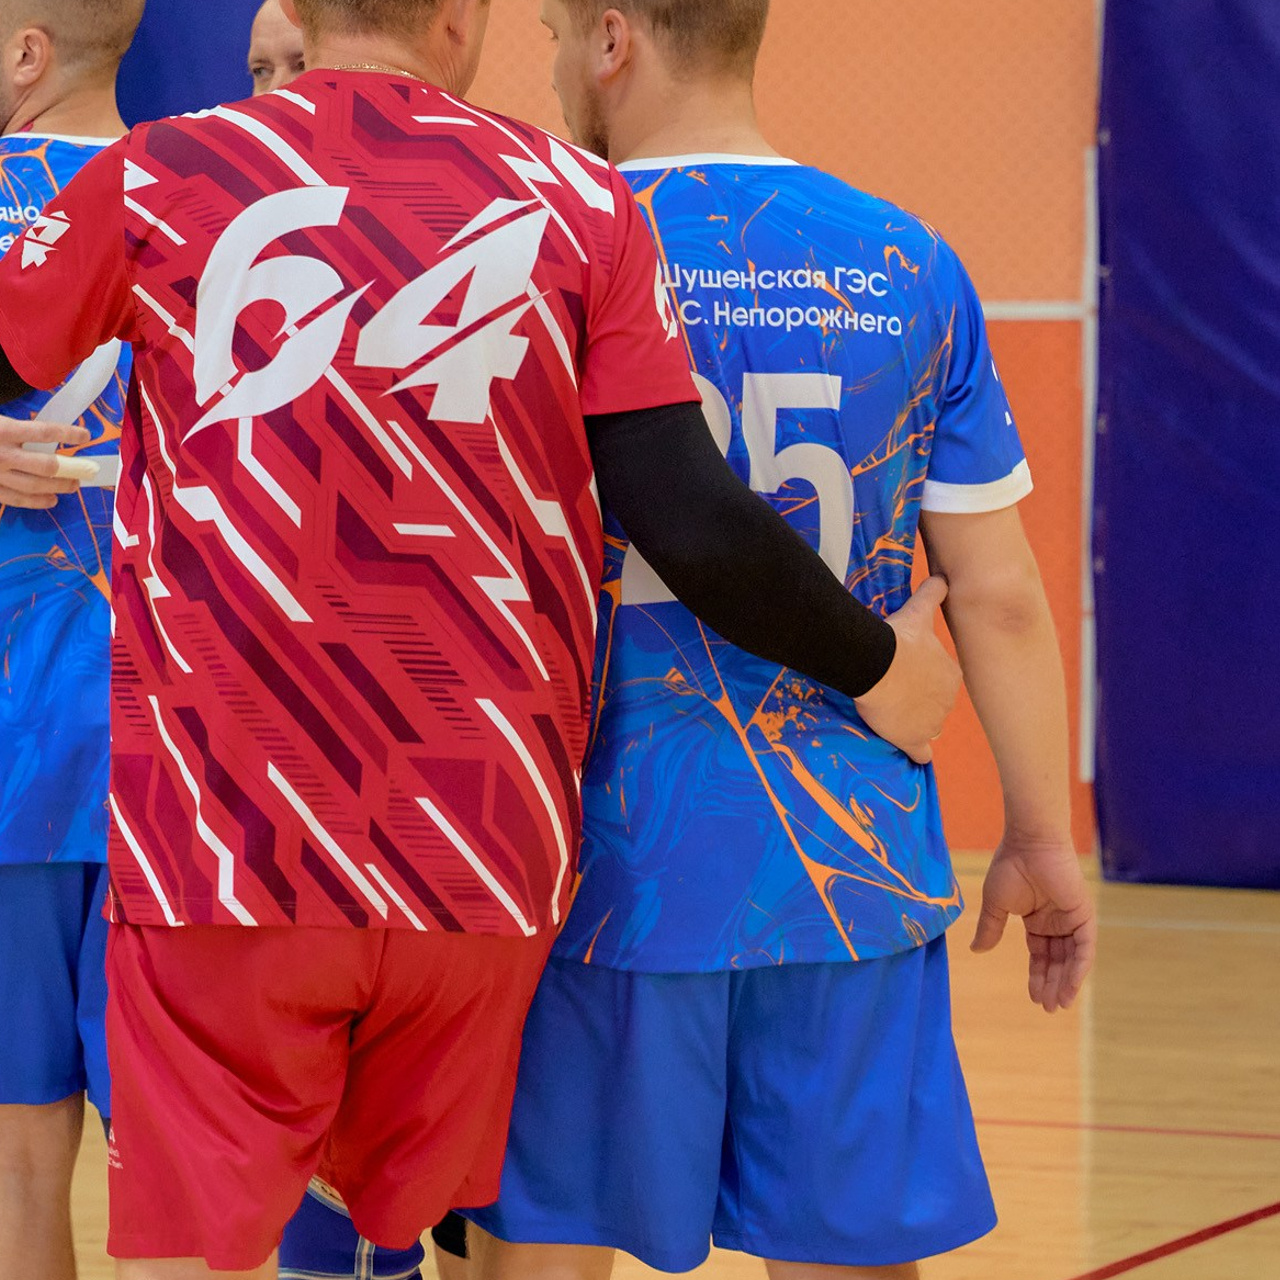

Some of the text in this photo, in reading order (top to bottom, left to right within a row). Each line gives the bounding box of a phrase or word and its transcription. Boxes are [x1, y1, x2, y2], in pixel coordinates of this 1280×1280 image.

[834, 266, 888, 297] ГЭС
[181, 186, 551, 446] 64
[714, 301, 902, 336] Непорожнего
